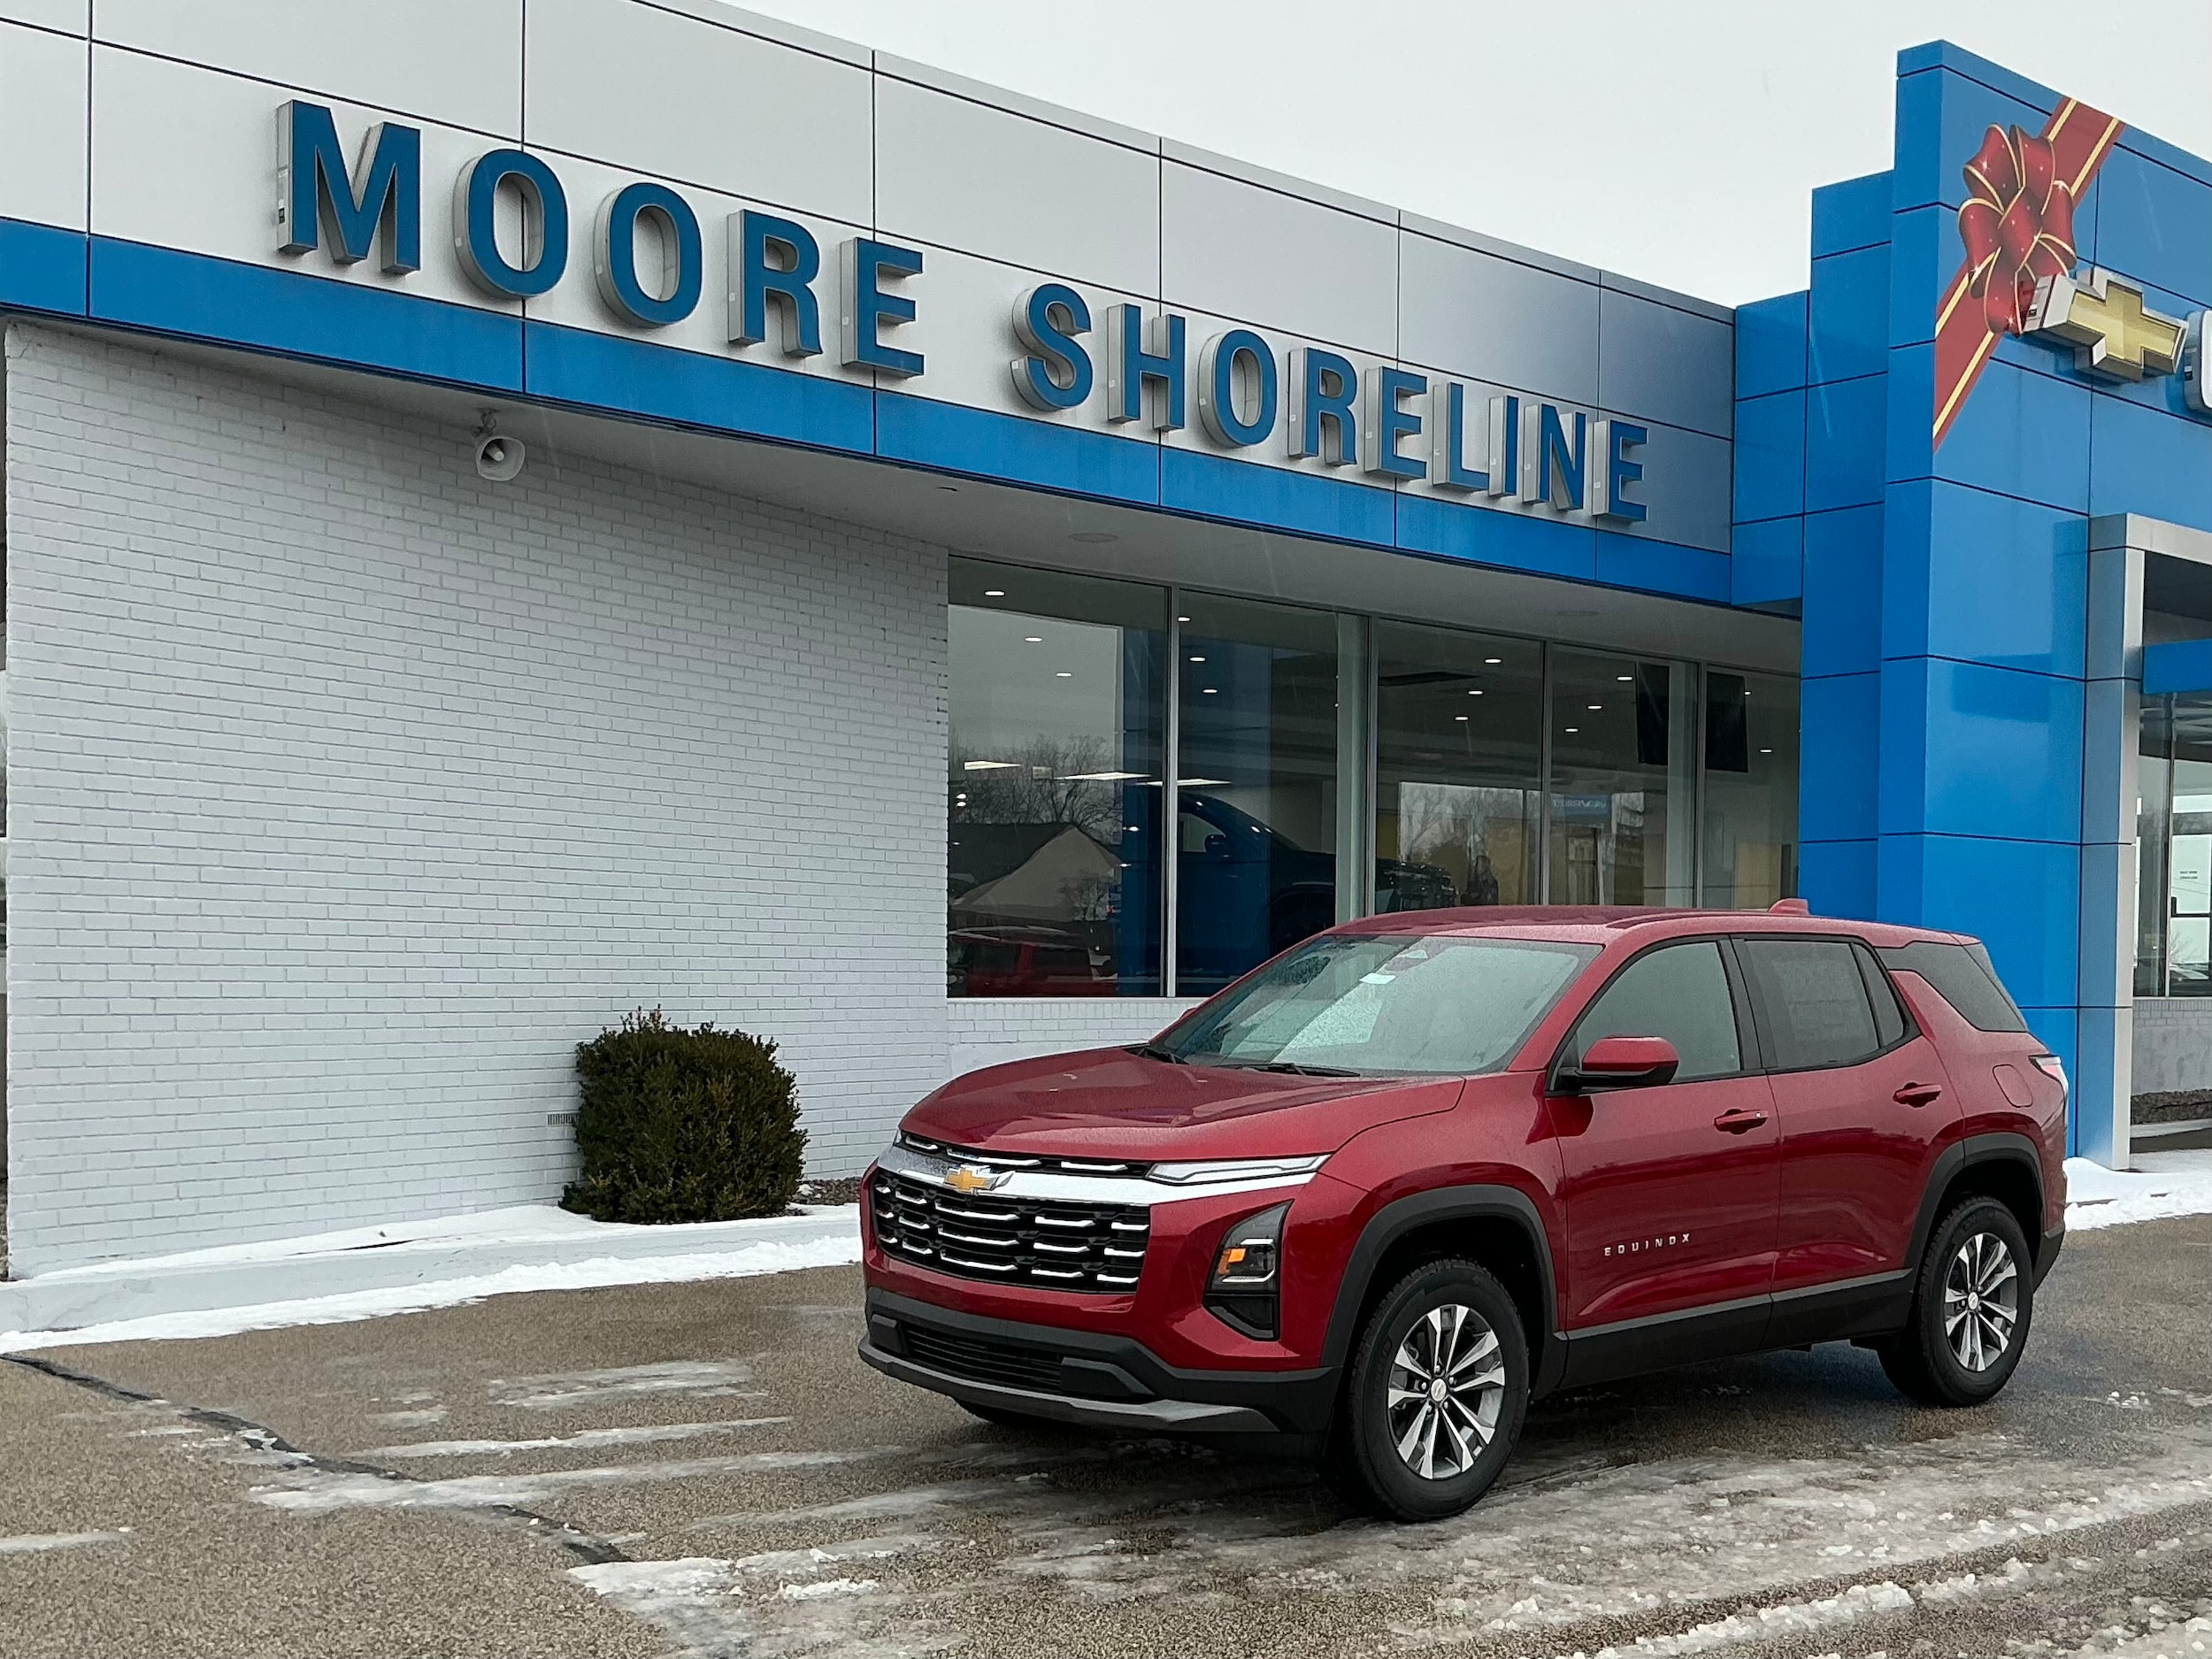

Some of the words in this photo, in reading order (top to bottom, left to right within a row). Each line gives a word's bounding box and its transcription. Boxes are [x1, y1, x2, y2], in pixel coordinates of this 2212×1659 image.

[279, 99, 925, 379] MOORE
[1012, 283, 1648, 522] SHORELINE
[1603, 1233, 1690, 1256] EQUINOX
